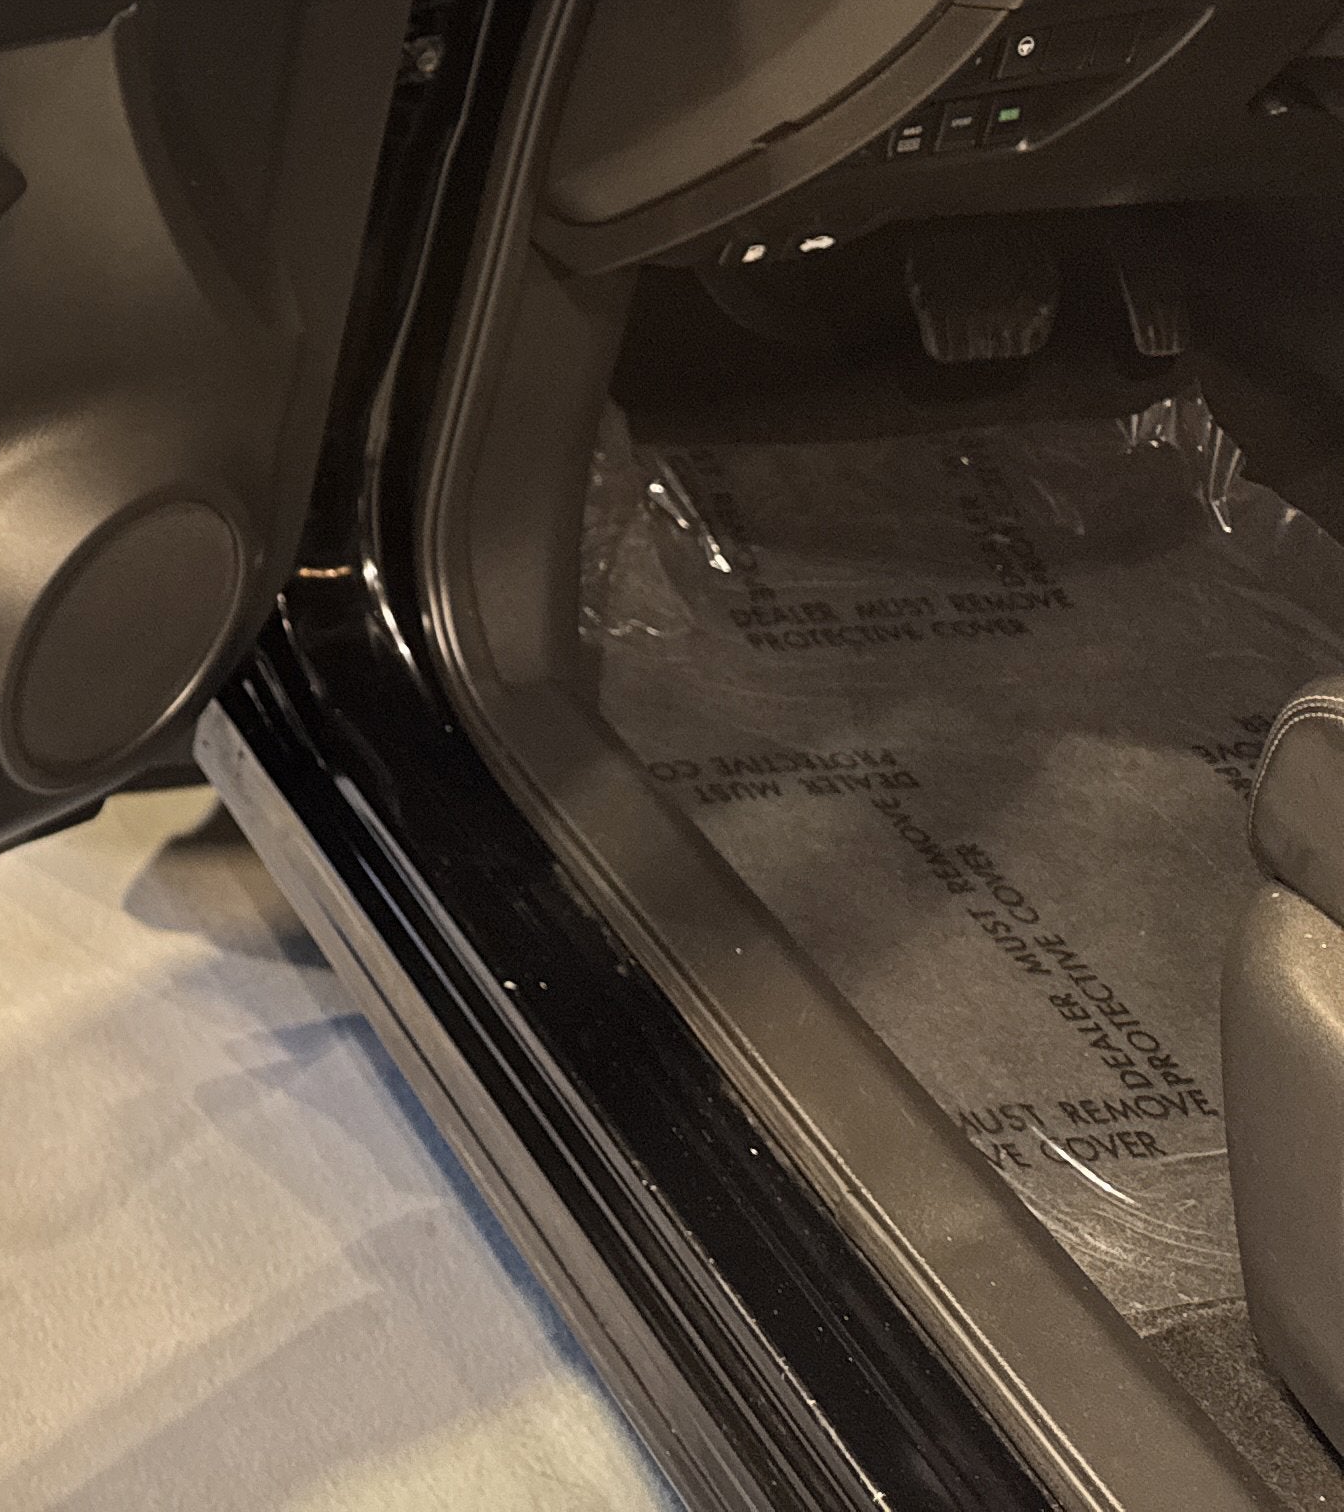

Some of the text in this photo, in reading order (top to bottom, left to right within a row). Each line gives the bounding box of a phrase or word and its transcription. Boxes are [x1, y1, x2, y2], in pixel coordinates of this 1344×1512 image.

[854, 595, 937, 620] MUST
[948, 588, 1074, 615] REMOVE
[746, 618, 1030, 652] PROTECTIVE COVER
[694, 780, 783, 804] MUST
[871, 797, 1154, 1090] DEALER MUST REMOVE
[955, 843, 1195, 1089] PROTECTIVE COVER
[1058, 1089, 1219, 1126] REMOVE
[1040, 1131, 1167, 1163] COVER
